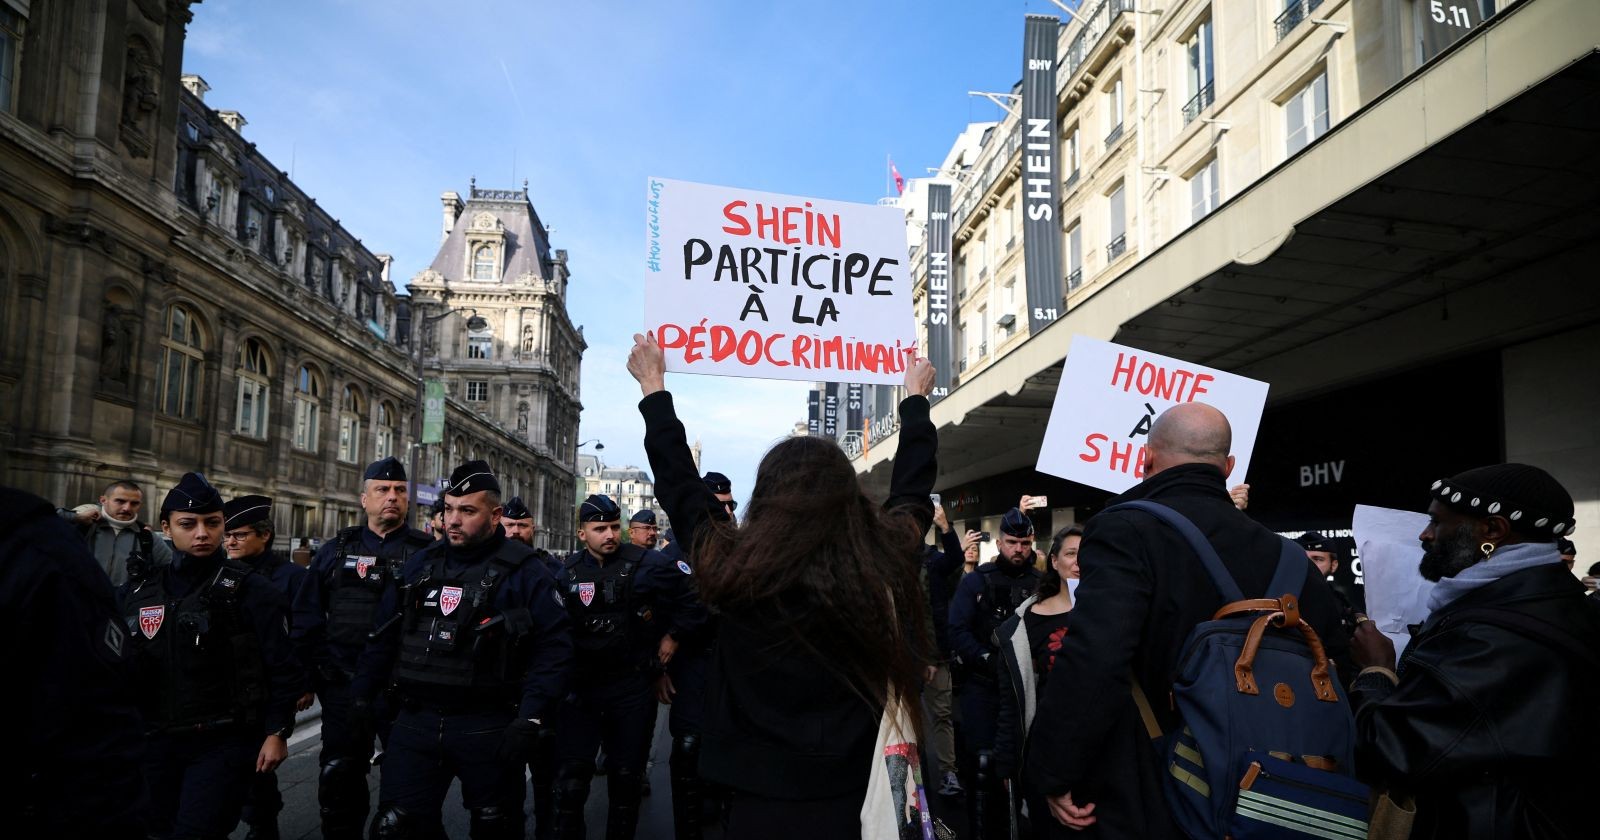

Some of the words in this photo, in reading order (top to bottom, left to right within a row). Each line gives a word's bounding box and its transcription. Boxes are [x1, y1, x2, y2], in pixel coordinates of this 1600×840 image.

[1430, 0, 1471, 29] 5.11
[1029, 59, 1052, 71] BHV
[1027, 118, 1053, 222] SHEIN
[722, 200, 841, 248] SHEIN
[931, 211, 948, 221] BHV
[683, 238, 899, 296] PARTICIPE
[739, 284, 768, 322] À
[792, 294, 840, 327] LA
[930, 252, 948, 326] SHEIN
[1034, 307, 1058, 321] 5.11
[1110, 352, 1215, 404] HONTE
[849, 383, 861, 410] SHE
[826, 395, 836, 435] SHEIN
[1079, 433, 1146, 479] SHE
[1300, 460, 1345, 487] BHV
[442, 595, 458, 604] CRS
[142, 616, 160, 625] CRS
